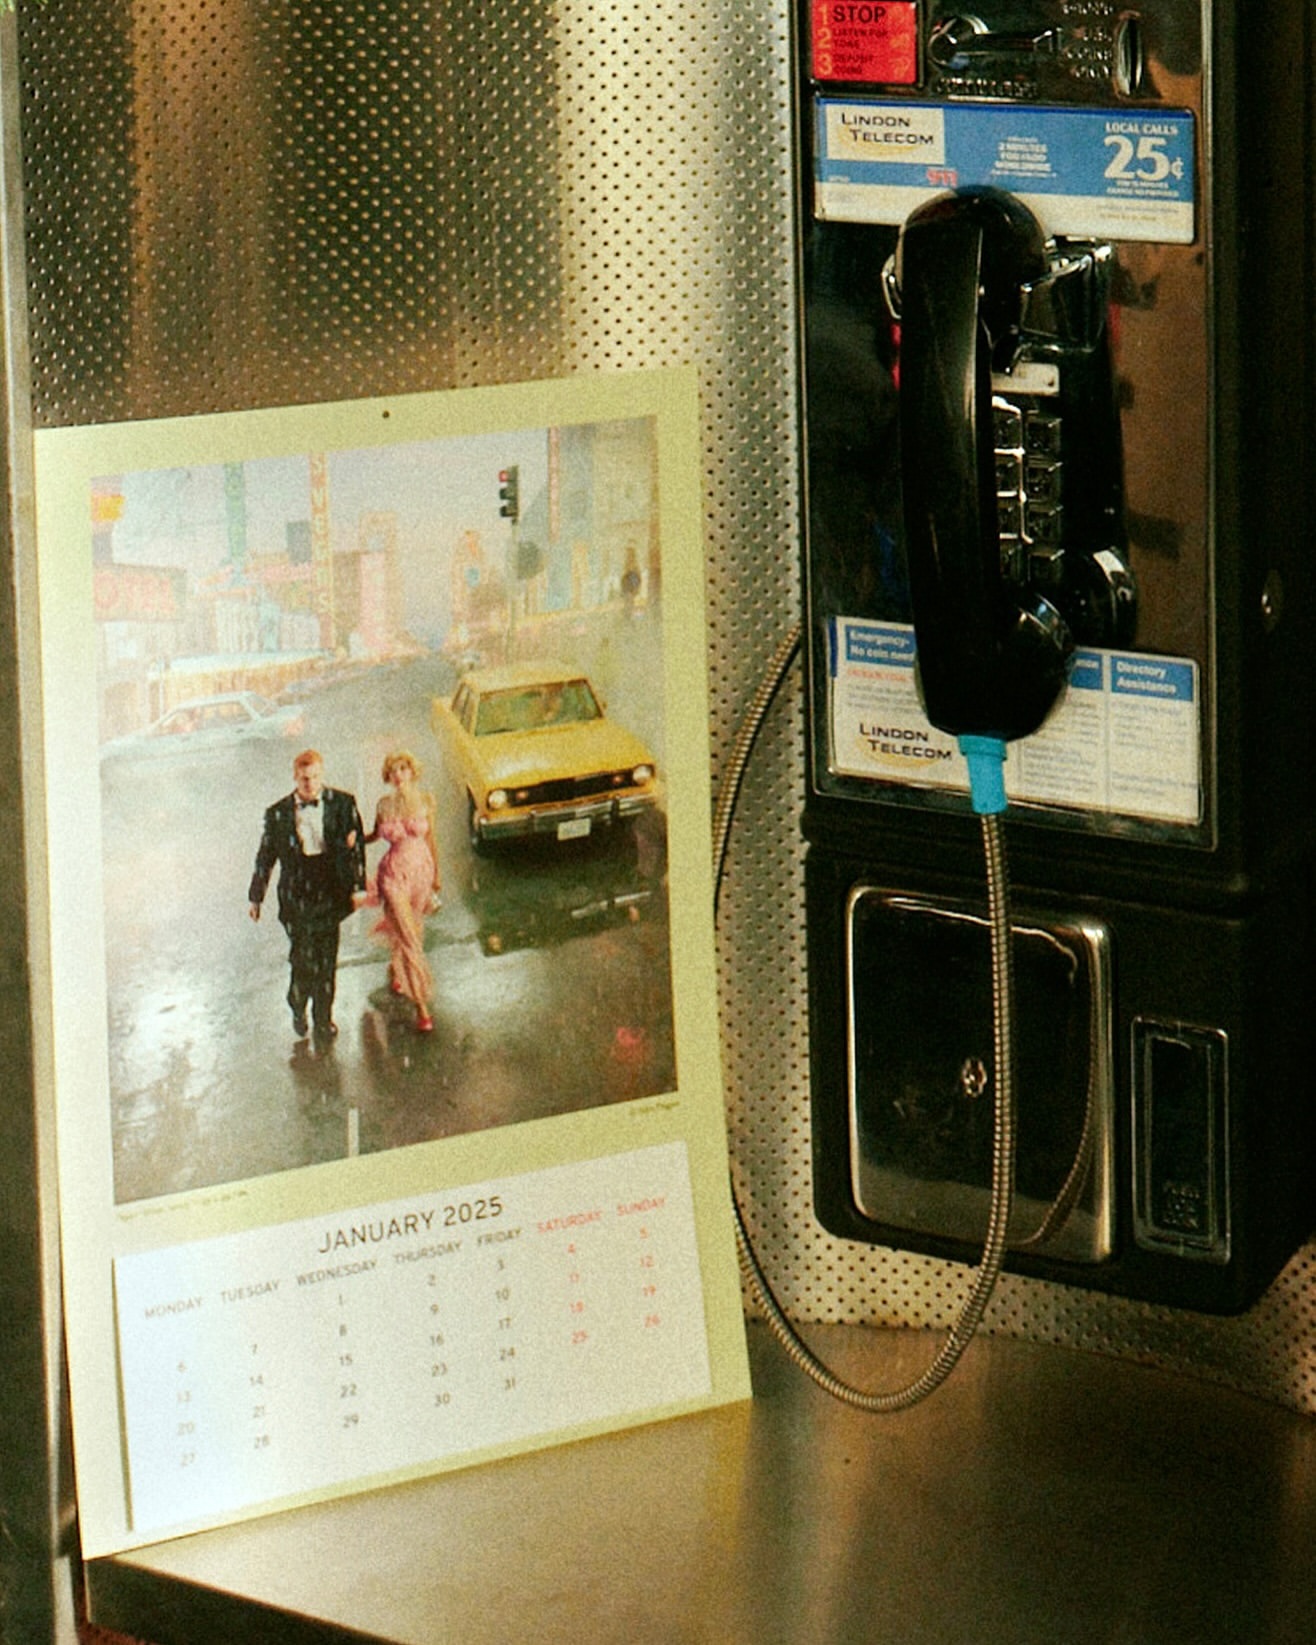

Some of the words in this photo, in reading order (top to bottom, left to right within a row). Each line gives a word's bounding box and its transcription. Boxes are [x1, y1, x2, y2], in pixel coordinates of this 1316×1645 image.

[819, 4, 828, 25] 1
[833, 5, 887, 23] STOP
[817, 27, 831, 49] 2
[818, 52, 832, 76] 3
[841, 112, 911, 127] LINDON
[1105, 121, 1140, 135] LOCAL
[1142, 123, 1179, 136] CALLS
[850, 129, 934, 145] TELECOM
[850, 644, 865, 657] No
[1116, 660, 1167, 680] Directory
[1116, 676, 1176, 694] Assistance
[859, 723, 929, 742] LINDON
[867, 739, 952, 760] TELECOM
[318, 1209, 435, 1254] JANUARY
[443, 1196, 503, 1227] 2025
[144, 1296, 202, 1320] MONDAY
[220, 1279, 280, 1305] TUESDAY
[296, 1259, 377, 1286] WEDNESDAY
[394, 1240, 463, 1265] THURSDAY
[476, 1227, 522, 1248] FRIDAY
[536, 1210, 602, 1234] SATURDAY
[616, 1197, 665, 1217] SUNDAY
